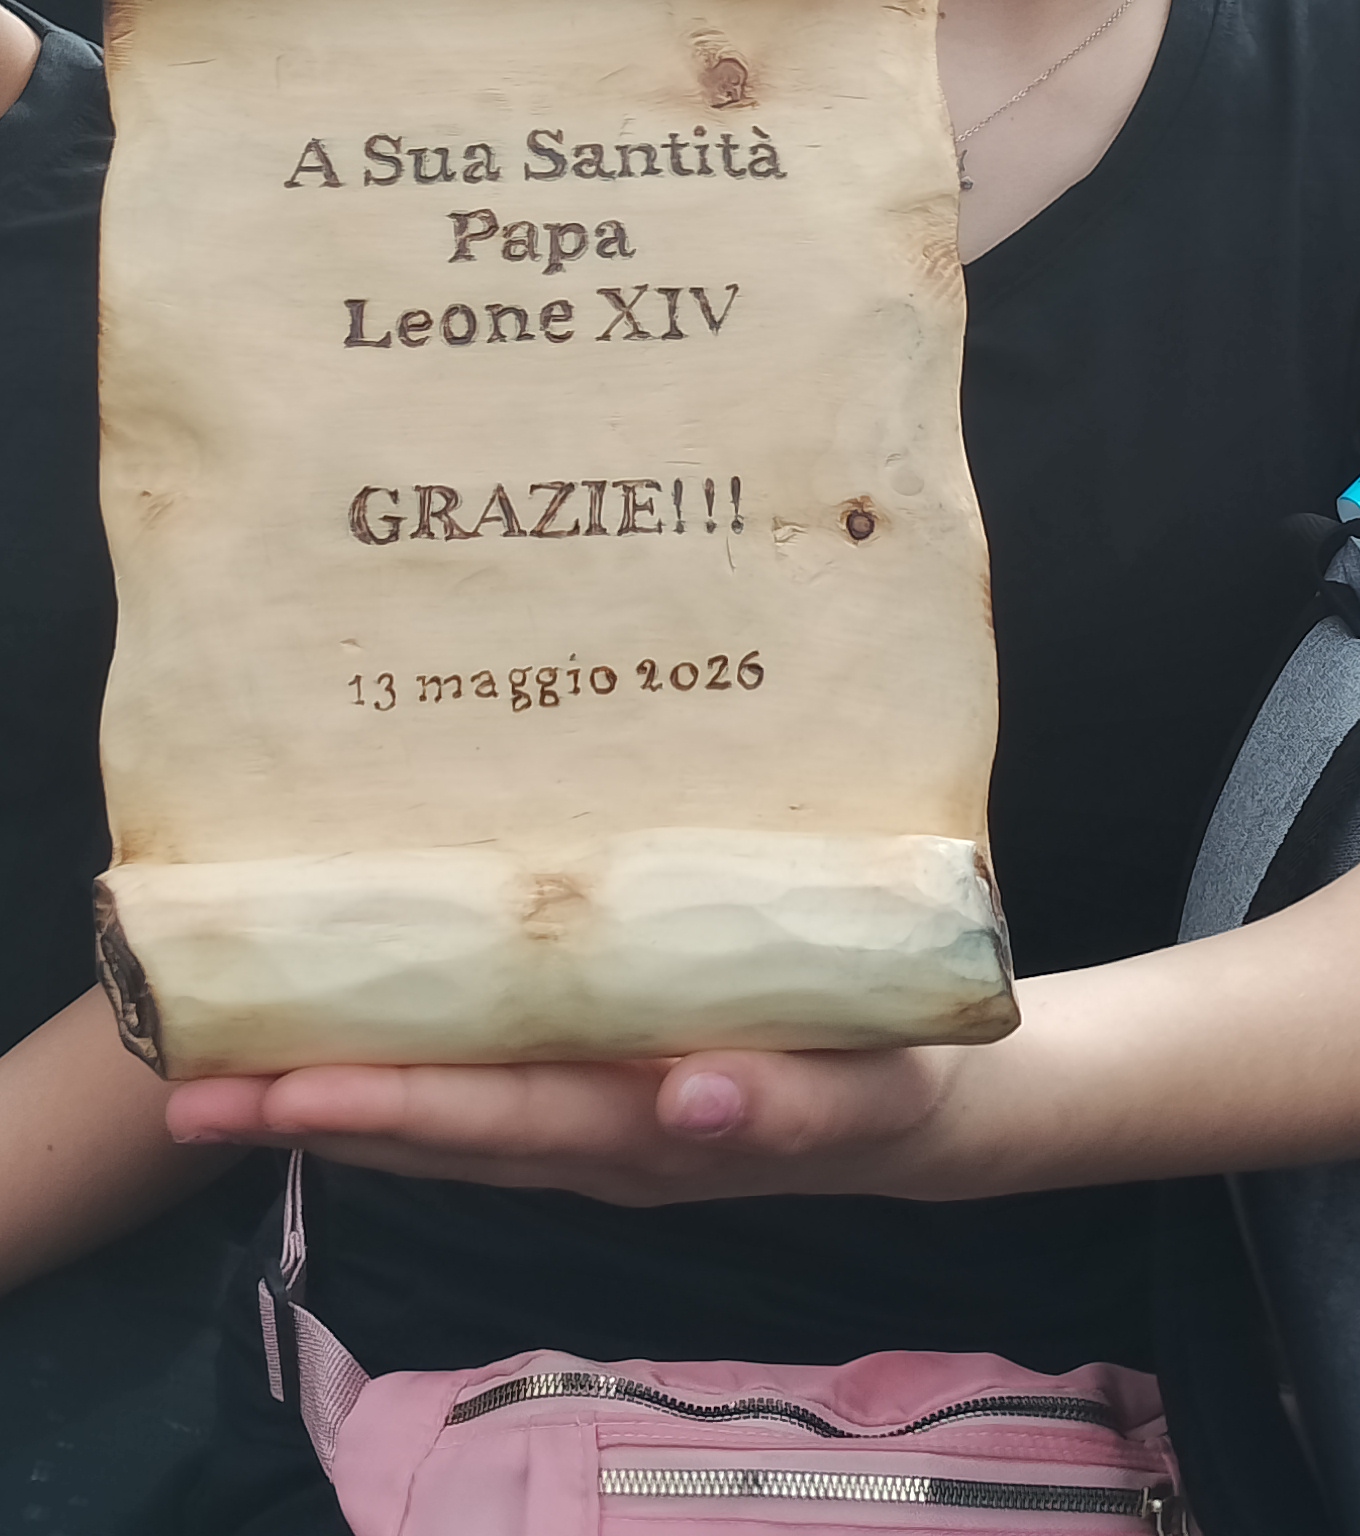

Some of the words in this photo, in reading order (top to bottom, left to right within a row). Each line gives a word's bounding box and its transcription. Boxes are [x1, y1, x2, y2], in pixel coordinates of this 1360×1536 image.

[284, 138, 342, 189] A
[362, 134, 502, 187] Sua
[522, 125, 789, 183] Santità
[447, 208, 638, 276] Papa
[343, 298, 576, 349] Leone
[593, 282, 741, 344] XIV
[347, 475, 746, 545] GRAZIE!!!
[347, 672, 398, 712] 13
[417, 653, 619, 713] maggio
[635, 649, 767, 694] 2026
